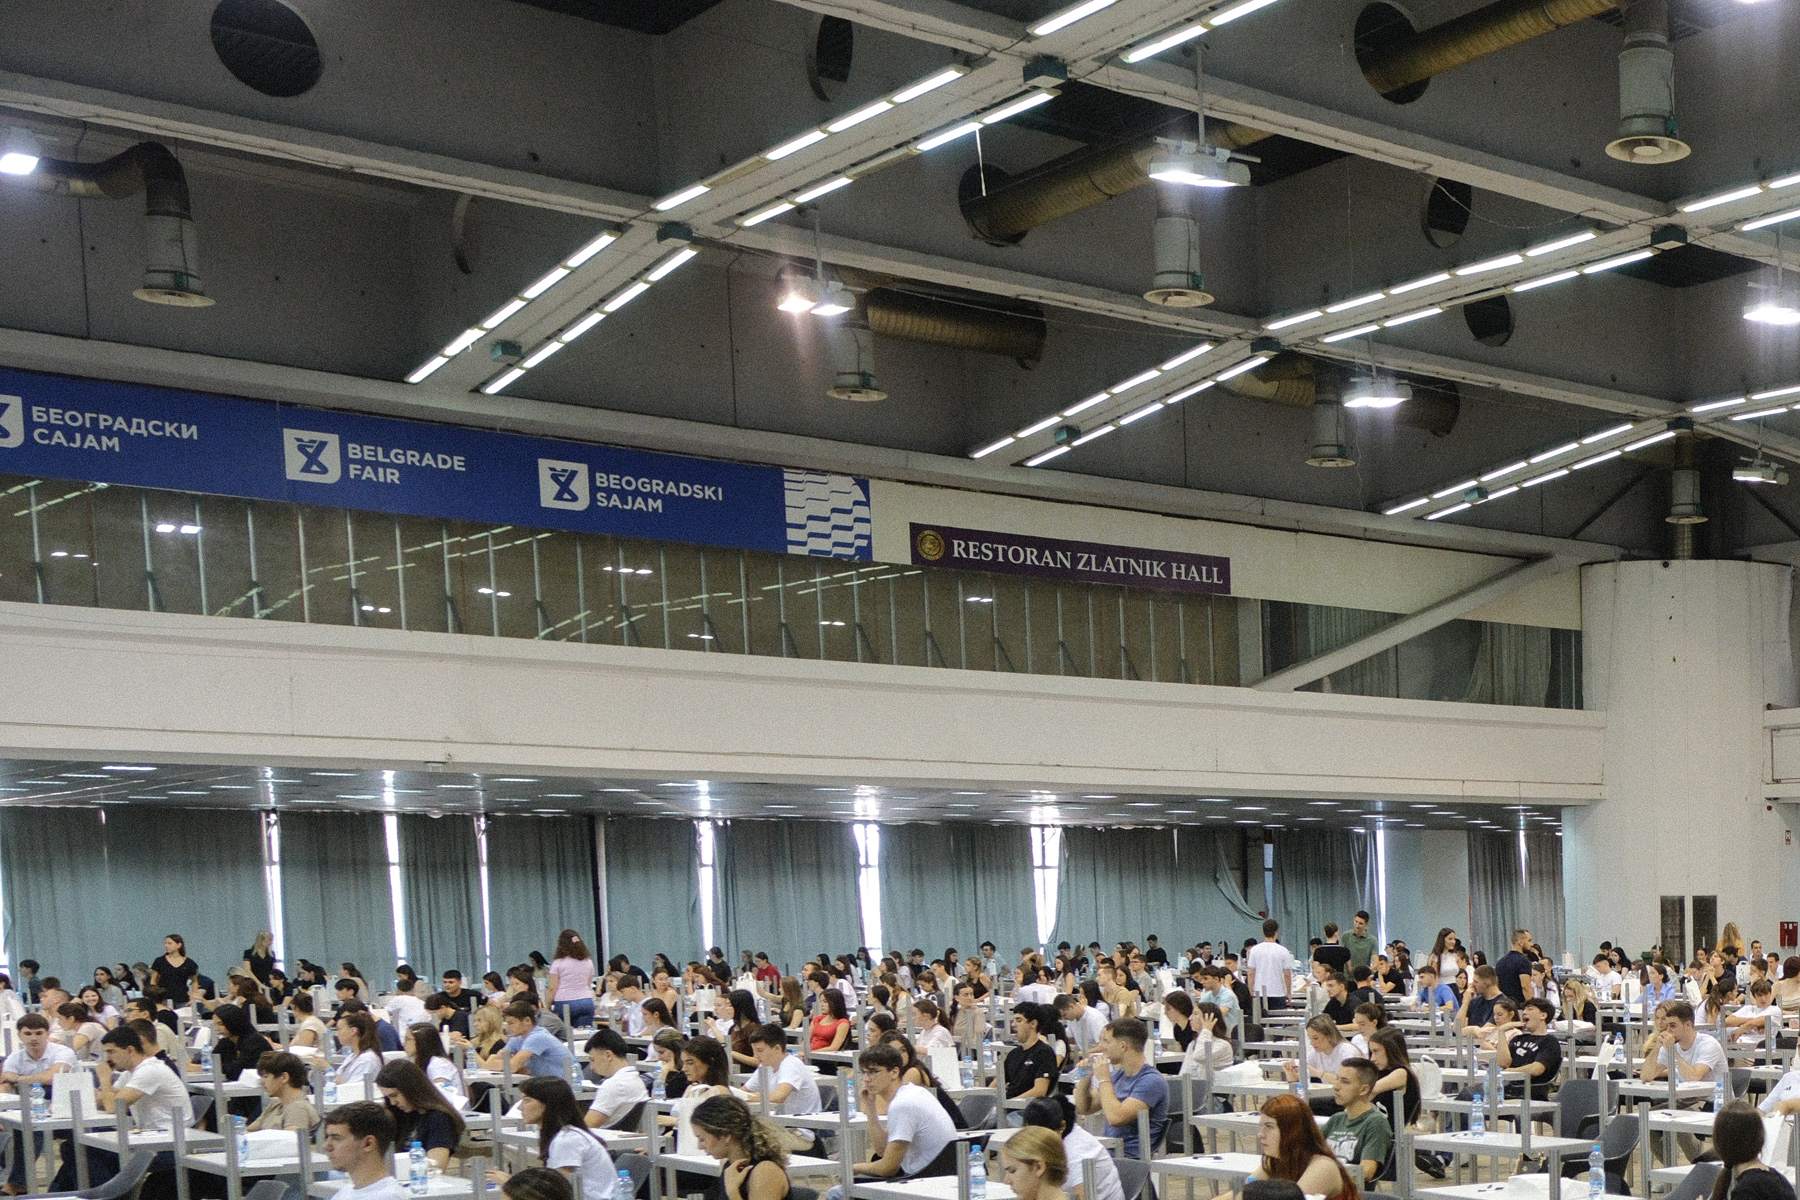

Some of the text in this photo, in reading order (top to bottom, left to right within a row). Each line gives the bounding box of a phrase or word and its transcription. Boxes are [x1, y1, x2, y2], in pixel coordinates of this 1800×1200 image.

[32, 406, 198, 440] БЕОГРАДСКИ
[33, 428, 120, 452] САЈАМ
[347, 443, 467, 472] BELGRADE
[349, 464, 400, 484] FAIR
[595, 472, 723, 501] BEOGRADSKI
[596, 492, 663, 513] SAJAM
[952, 540, 1223, 584] RESTORAN ZLATNIK HALL
